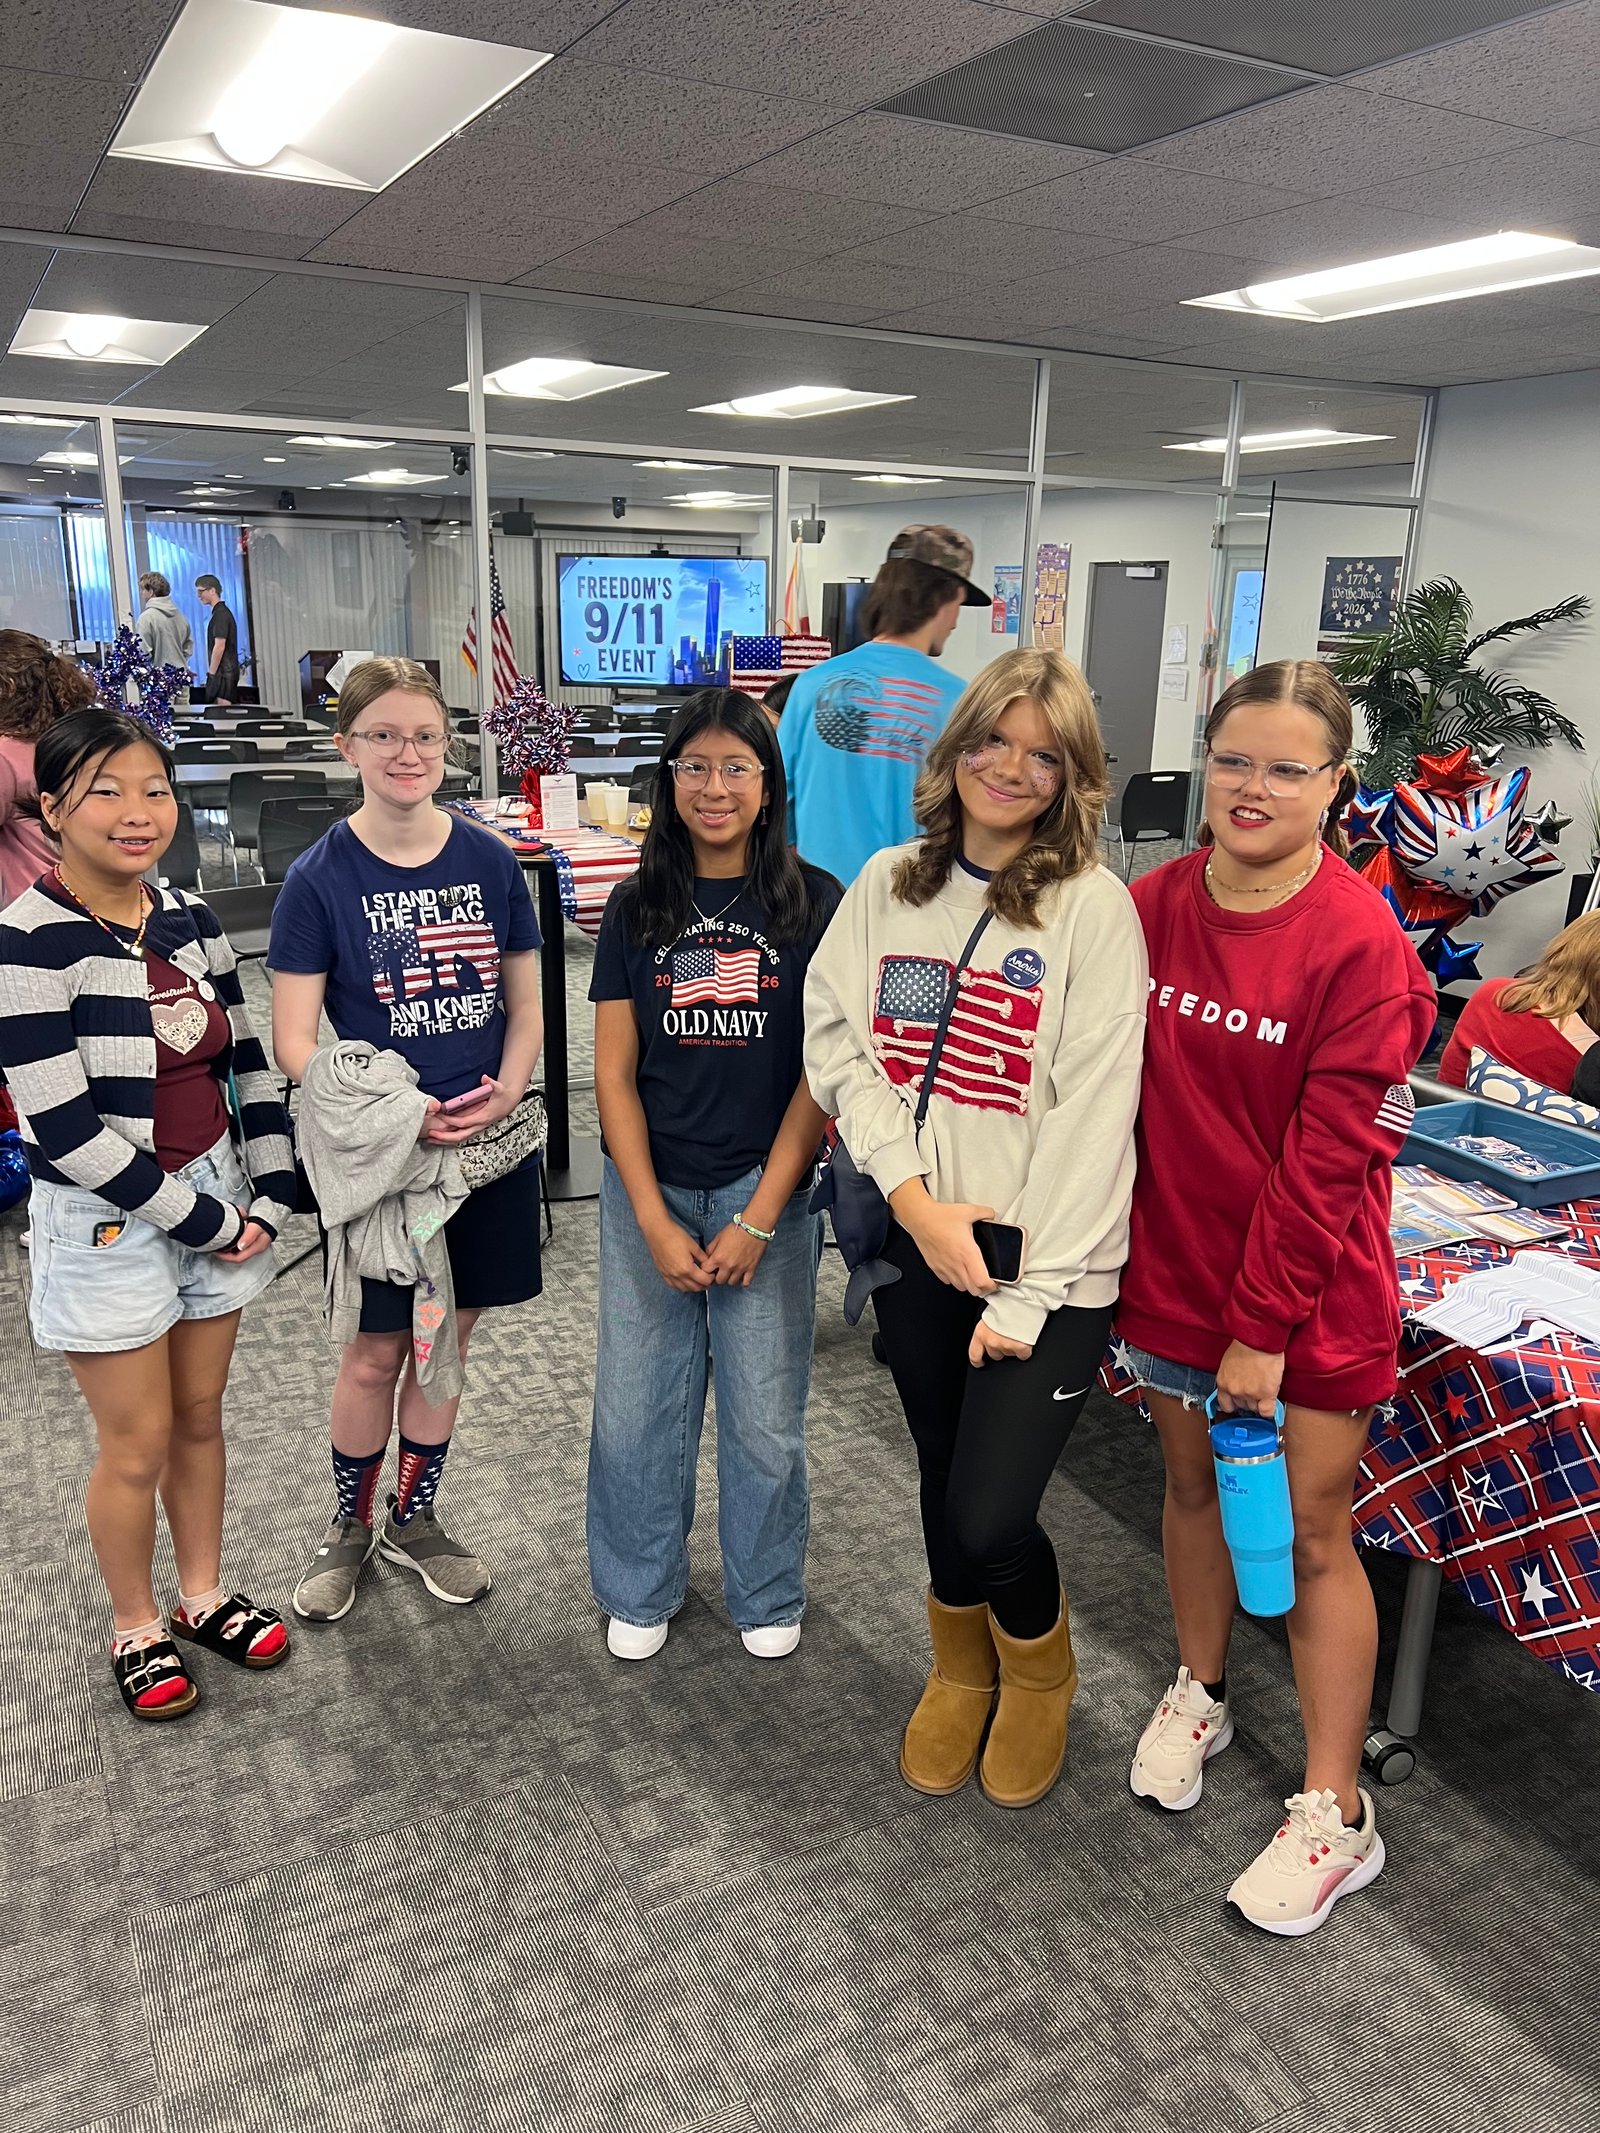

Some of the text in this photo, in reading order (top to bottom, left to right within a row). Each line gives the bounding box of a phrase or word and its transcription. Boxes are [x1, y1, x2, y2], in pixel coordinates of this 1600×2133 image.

[577, 576, 672, 600] FREEDOM'S
[1347, 574, 1368, 585] 1776
[1356, 587, 1383, 602] People
[1343, 603, 1365, 614] 2026
[584, 601, 665, 645] 9/11
[598, 649, 656, 673] EVENT
[361, 895, 369, 913] I
[372, 889, 437, 911] STAND
[365, 900, 485, 933] THE FLAG
[654, 920, 780, 966] CELRATING 250 YEARS
[1007, 955, 1040, 977] America
[655, 974, 780, 988] 20 26
[389, 1000, 430, 1023] AND
[663, 1009, 769, 1038] OLD NAVY
[390, 1010, 493, 1038] FOR THE CRO
[678, 1039, 748, 1047] AMERICAN TRADITION
